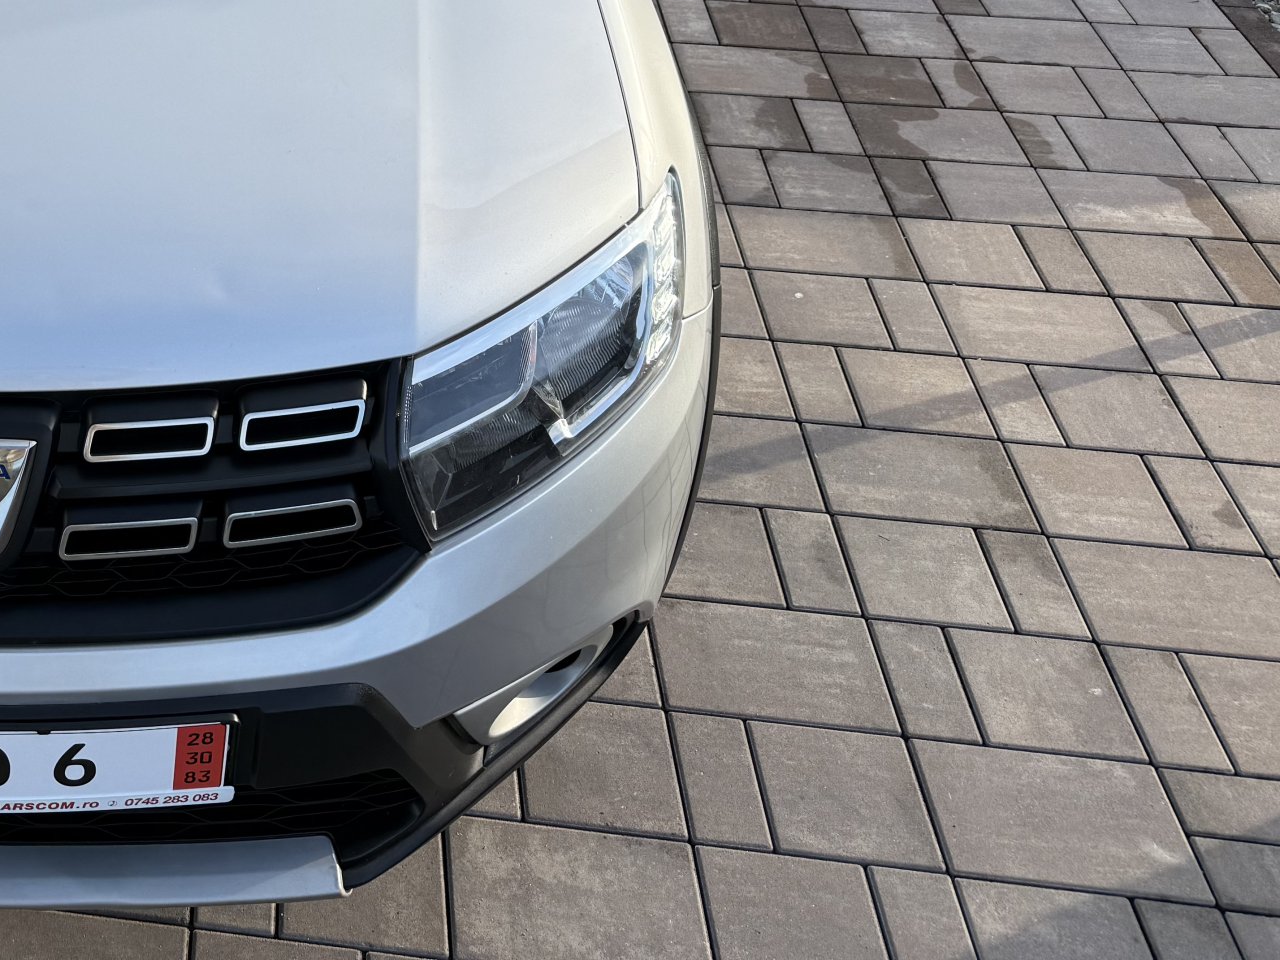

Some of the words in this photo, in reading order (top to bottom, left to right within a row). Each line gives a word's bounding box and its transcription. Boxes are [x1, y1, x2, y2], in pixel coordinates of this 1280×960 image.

[187, 732, 214, 746] 28
[53, 743, 97, 787] 6
[185, 751, 212, 765] 30
[184, 770, 211, 784] 83
[124, 796, 159, 806] 0745
[162, 794, 189, 804] 283
[192, 792, 219, 803] 083
